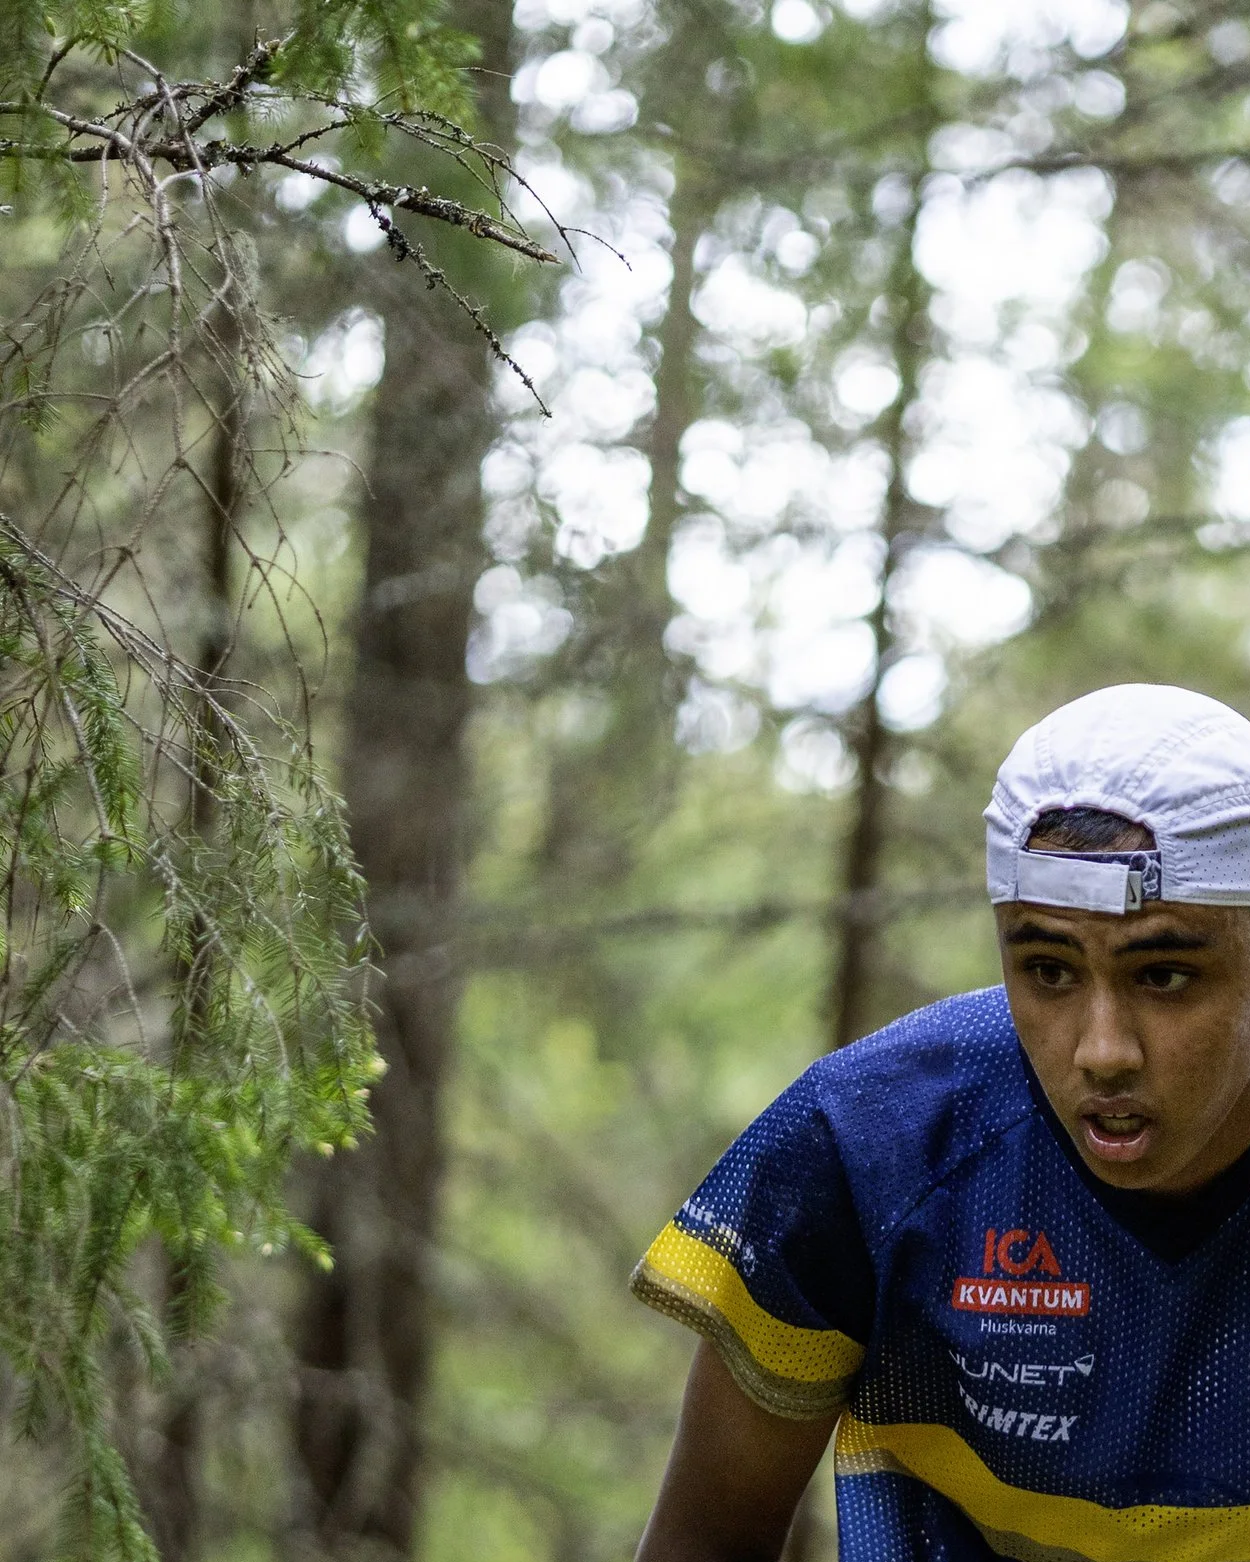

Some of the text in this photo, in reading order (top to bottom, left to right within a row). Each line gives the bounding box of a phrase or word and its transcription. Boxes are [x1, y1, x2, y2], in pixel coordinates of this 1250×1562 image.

[983, 1227, 1062, 1276] ICA
[959, 1284, 1083, 1309] KVANTUM
[980, 1318, 1057, 1335] Huskvarna
[957, 1379, 1078, 1442] TRIMTEX
